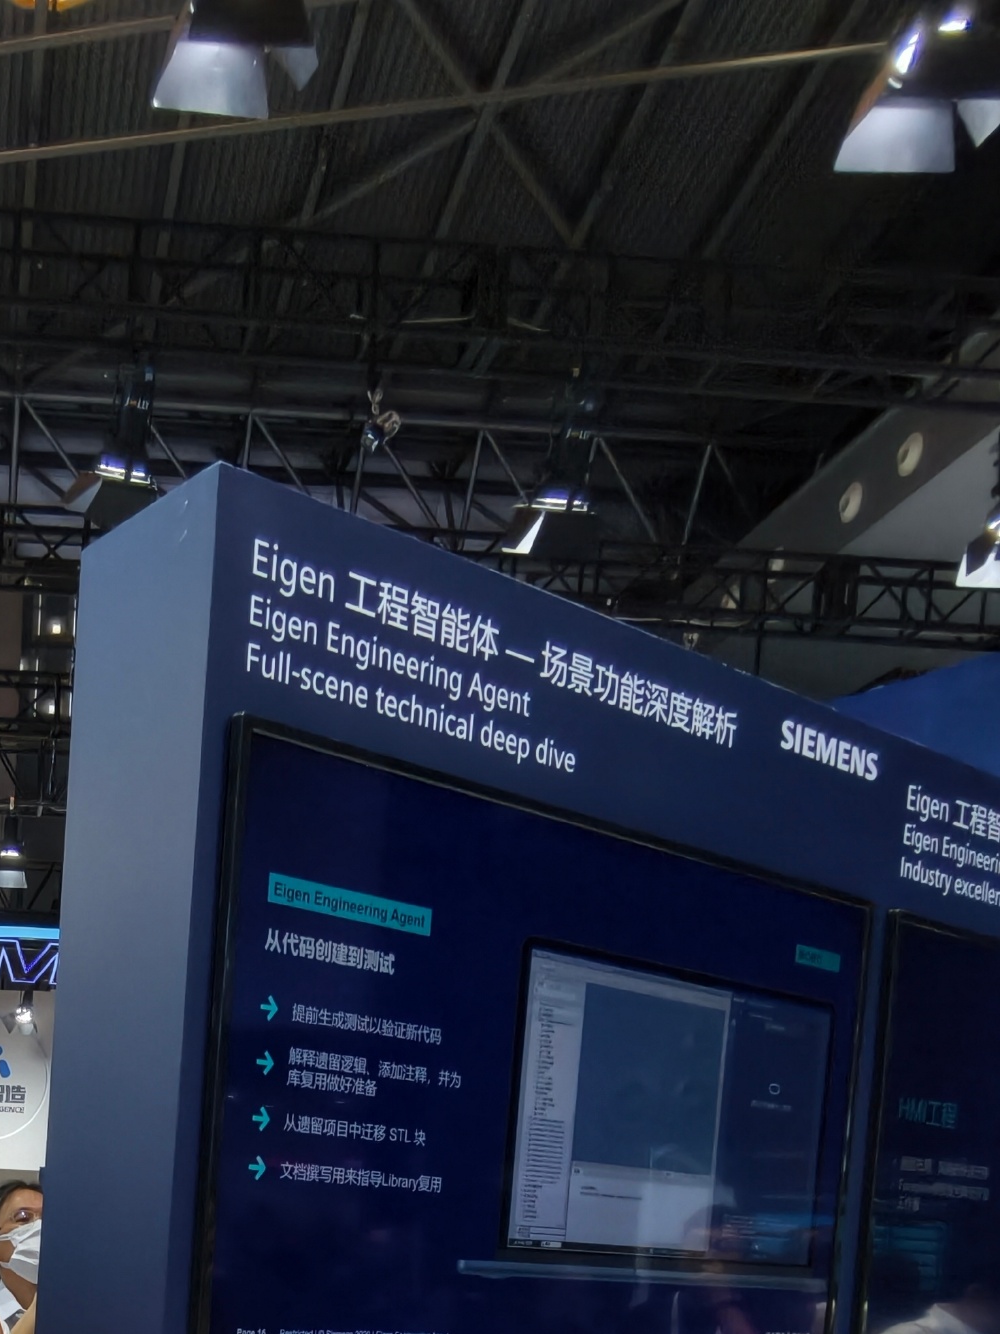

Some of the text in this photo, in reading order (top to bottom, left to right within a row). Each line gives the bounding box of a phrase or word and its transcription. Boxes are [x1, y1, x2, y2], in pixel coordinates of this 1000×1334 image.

[249, 594, 531, 717] Eigen Engineering Agent
[252, 538, 335, 597] Eigen
[345, 571, 500, 662] 工程智能体
[539, 640, 738, 749] 场景功能深度解析
[246, 642, 576, 773] Full-scene technical deep dive
[780, 719, 879, 781] SIEMENS
[906, 784, 950, 823] Eigen
[902, 823, 939, 854] Eigen
[900, 856, 953, 896] Industry
[273, 881, 426, 929] Eigen Engineering Agent
[264, 927, 396, 976] 从代码创建到测试
[291, 1003, 442, 1046] 提前生成测试以验证新代码
[286, 1069, 378, 1098] 库复用做好准备
[283, 1113, 427, 1147] 从遗留项目中迁移 STL 块
